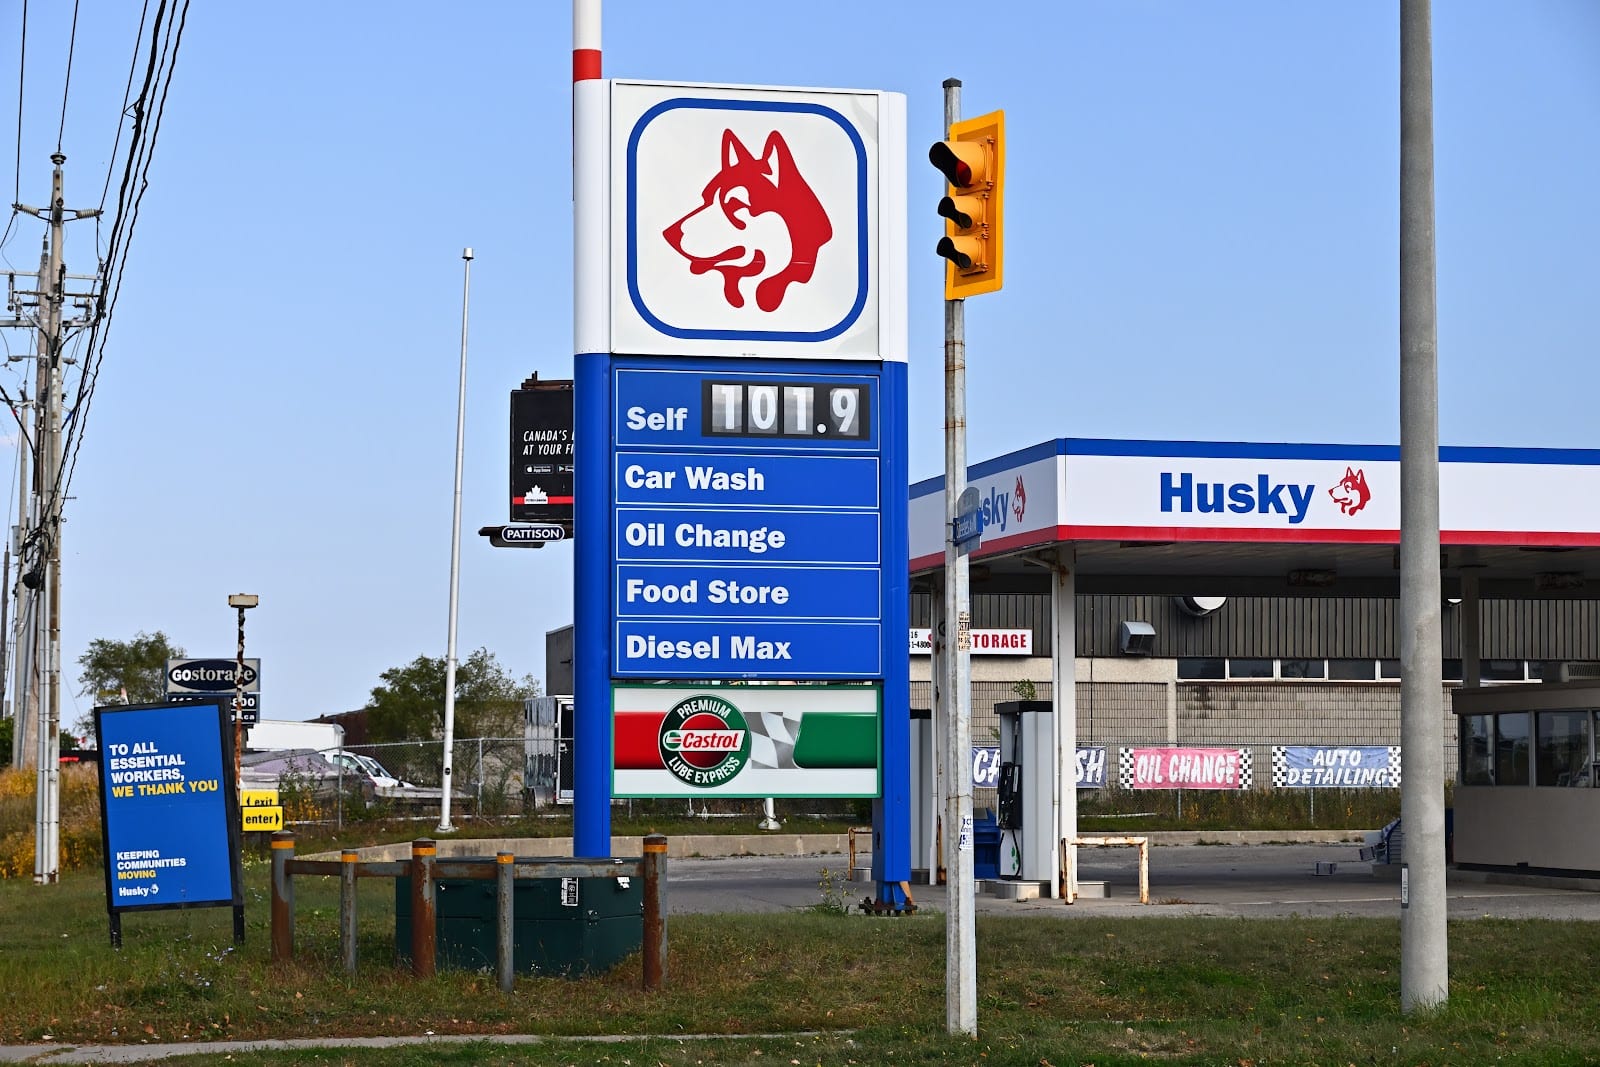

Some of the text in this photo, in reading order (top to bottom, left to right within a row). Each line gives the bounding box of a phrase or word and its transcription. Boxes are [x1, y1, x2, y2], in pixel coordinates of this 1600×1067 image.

[720, 384, 857, 434] 101.9
[626, 406, 688, 431] Self
[523, 430, 568, 442] CANADA'S
[522, 444, 534, 456] AT
[538, 444, 562, 456] YOUR
[624, 464, 765, 491] Car Wash
[1160, 472, 1316, 524] Husky
[982, 486, 1009, 532] sky
[506, 529, 560, 539] PATTISON
[625, 522, 786, 554] Oil Change
[626, 579, 790, 605] Food Store
[626, 635, 793, 660] Diesel Max
[972, 634, 1027, 649] TORAGE
[676, 699, 732, 719] PREMIUM
[109, 742, 159, 756] TO ALL
[682, 732, 739, 749] Castrol
[110, 754, 185, 770] ESSENTIAL
[973, 749, 1106, 783] CA SH
[1312, 749, 1362, 766] AUTO
[111, 768, 185, 783] WORKERS,
[668, 756, 741, 783] LUBE EXPRESS
[1136, 754, 1237, 784] OIL CHANGE
[1287, 767, 1388, 785] DETAILING
[112, 779, 218, 798] WE THANK YOU
[254, 796, 273, 806] exit
[245, 814, 273, 824] enter
[116, 850, 160, 860] KEEPING
[117, 858, 187, 870] COMMUNITIES
[117, 870, 156, 880] MOVING
[118, 886, 149, 897] Husky
